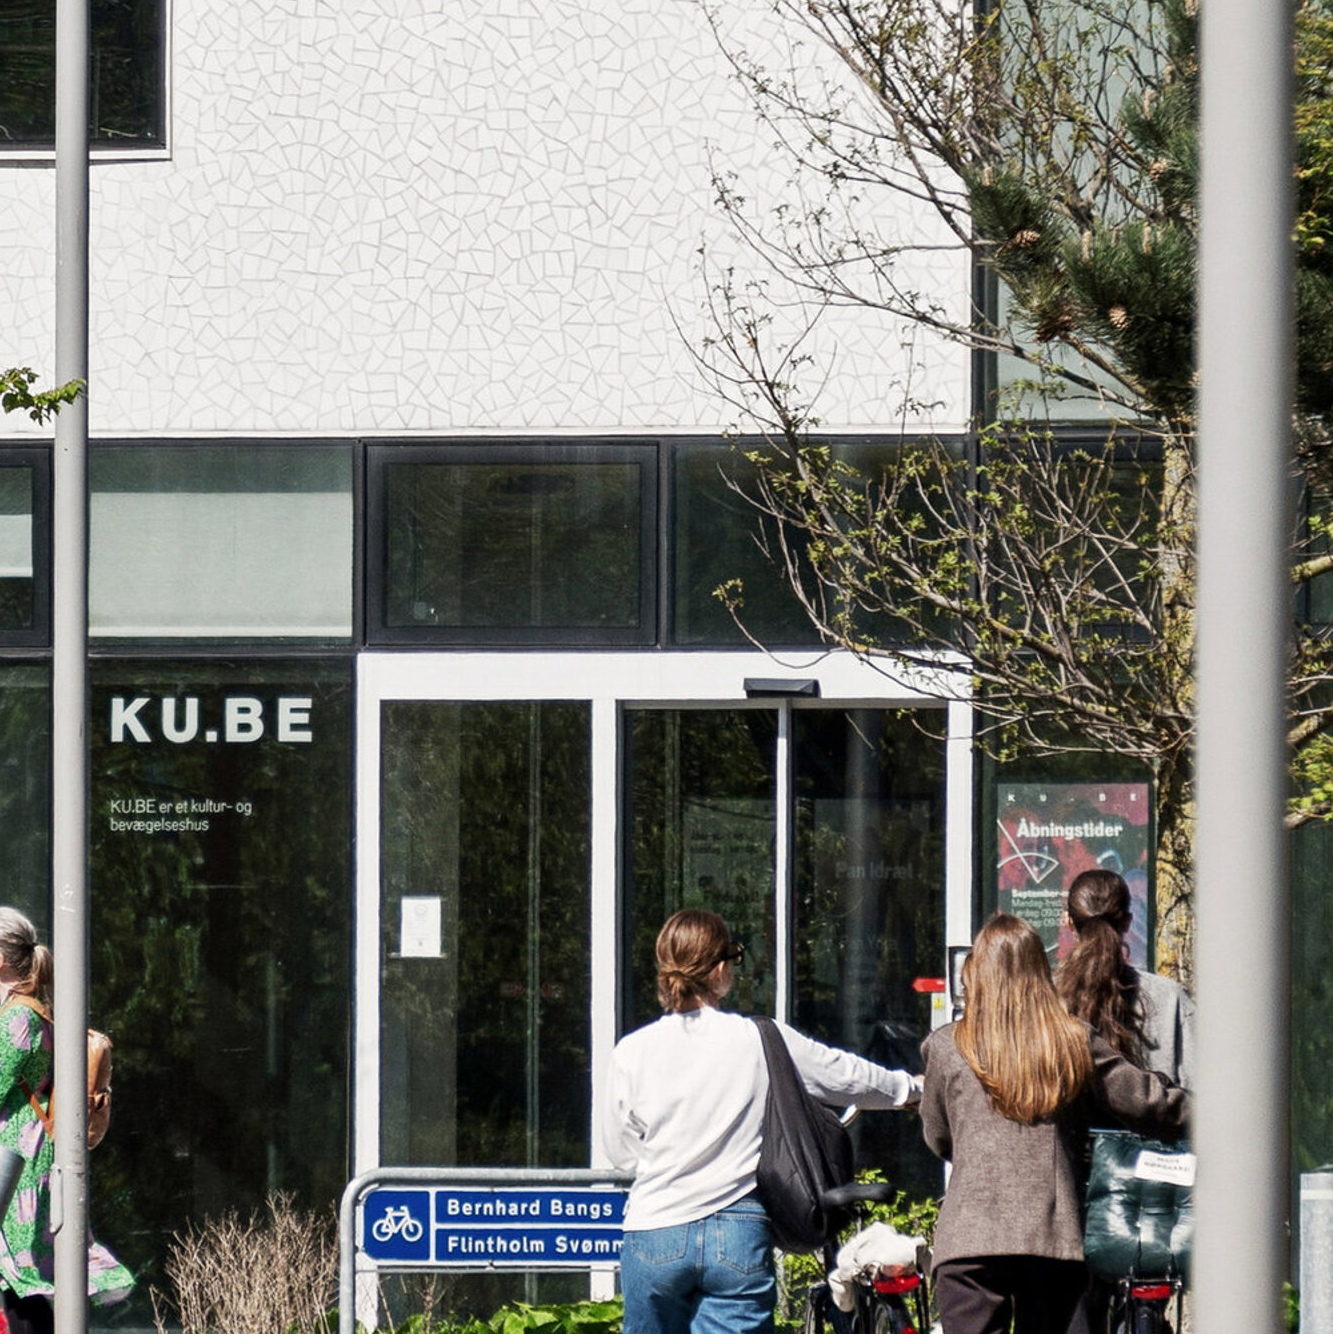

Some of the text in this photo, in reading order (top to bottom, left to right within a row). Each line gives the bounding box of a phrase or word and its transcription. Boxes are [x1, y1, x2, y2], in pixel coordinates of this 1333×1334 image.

[110, 697, 313, 743] KU.BE
[110, 798, 253, 817] KU.BE er et kultur- og
[110, 817, 210, 834] bevægelseshus
[1017, 817, 1124, 840] Åbningstider
[447, 1199, 541, 1216] Bernhard
[551, 1199, 612, 1219] Bangs
[447, 1236, 545, 1253] Flintholm
